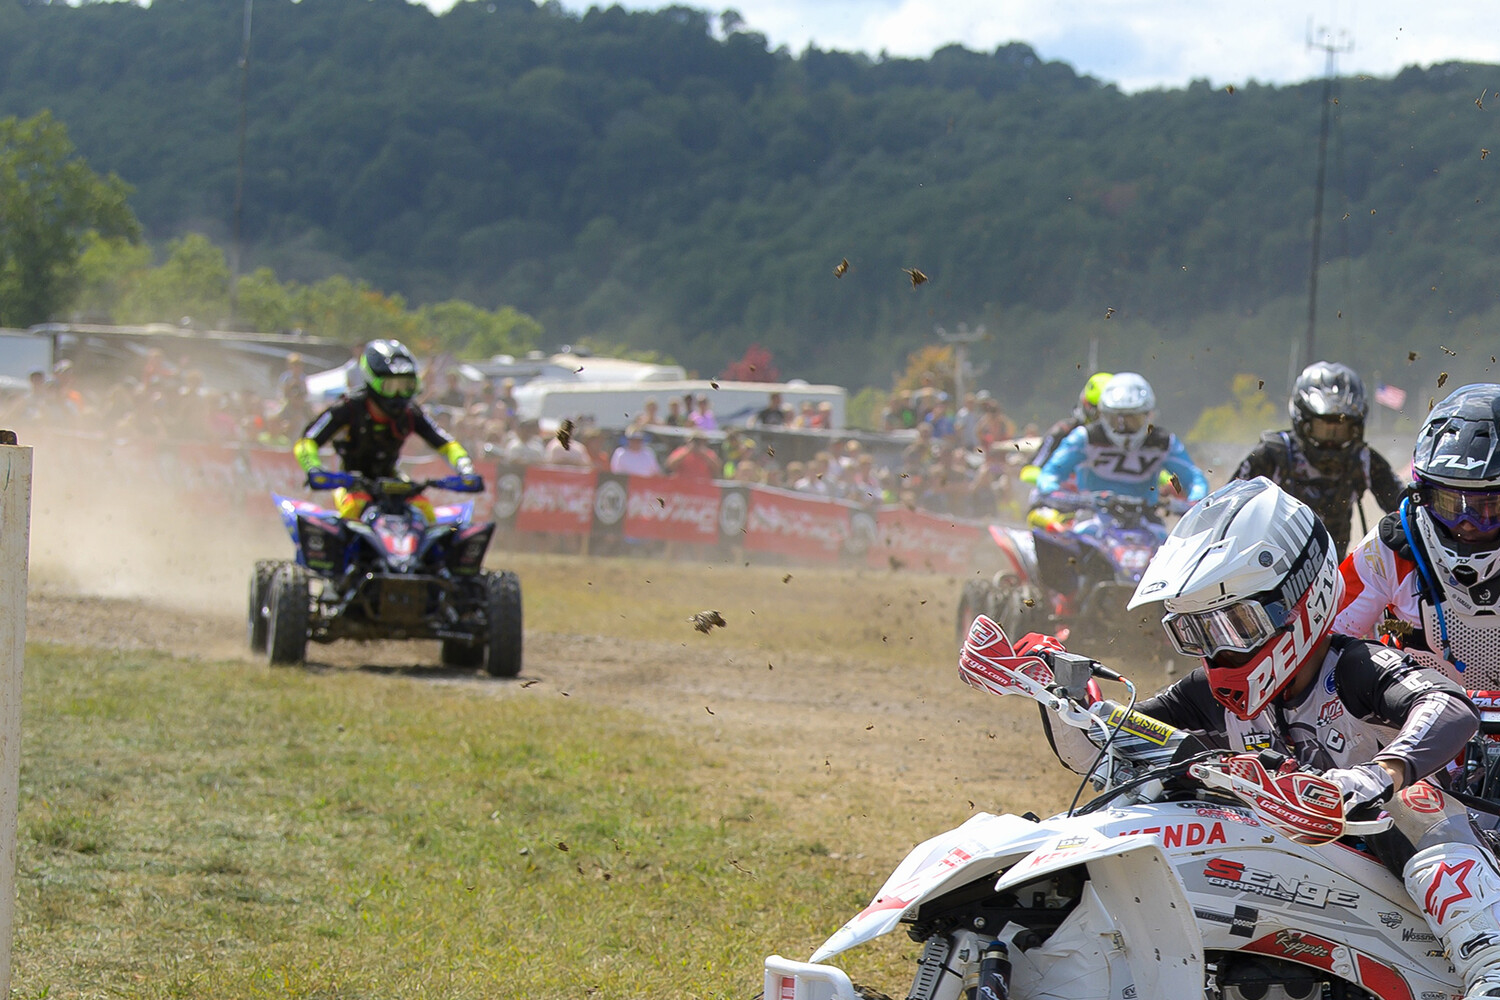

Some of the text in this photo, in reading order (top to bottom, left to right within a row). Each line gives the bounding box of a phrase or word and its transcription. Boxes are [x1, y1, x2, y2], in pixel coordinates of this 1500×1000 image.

[1093, 452, 1161, 480] FLY
[1429, 455, 1487, 470] FLY
[1208, 876, 1295, 901] GRAPHICS
